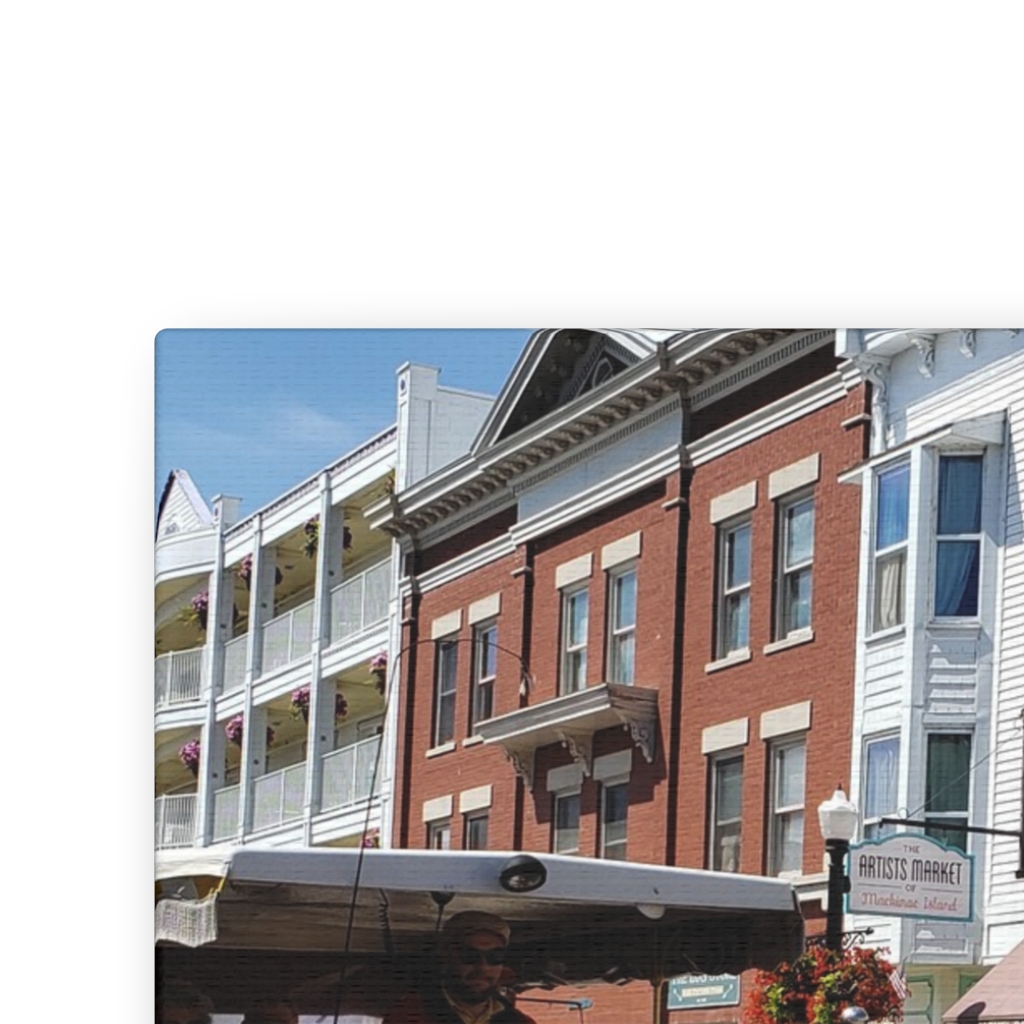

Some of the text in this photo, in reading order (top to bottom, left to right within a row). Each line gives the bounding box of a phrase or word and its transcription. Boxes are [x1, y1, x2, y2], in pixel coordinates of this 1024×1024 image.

[903, 844, 920, 853] THE
[859, 854, 962, 885] ARTISTS MARKET
[904, 884, 916, 892] OF
[861, 892, 958, 912] Mackinac Island
